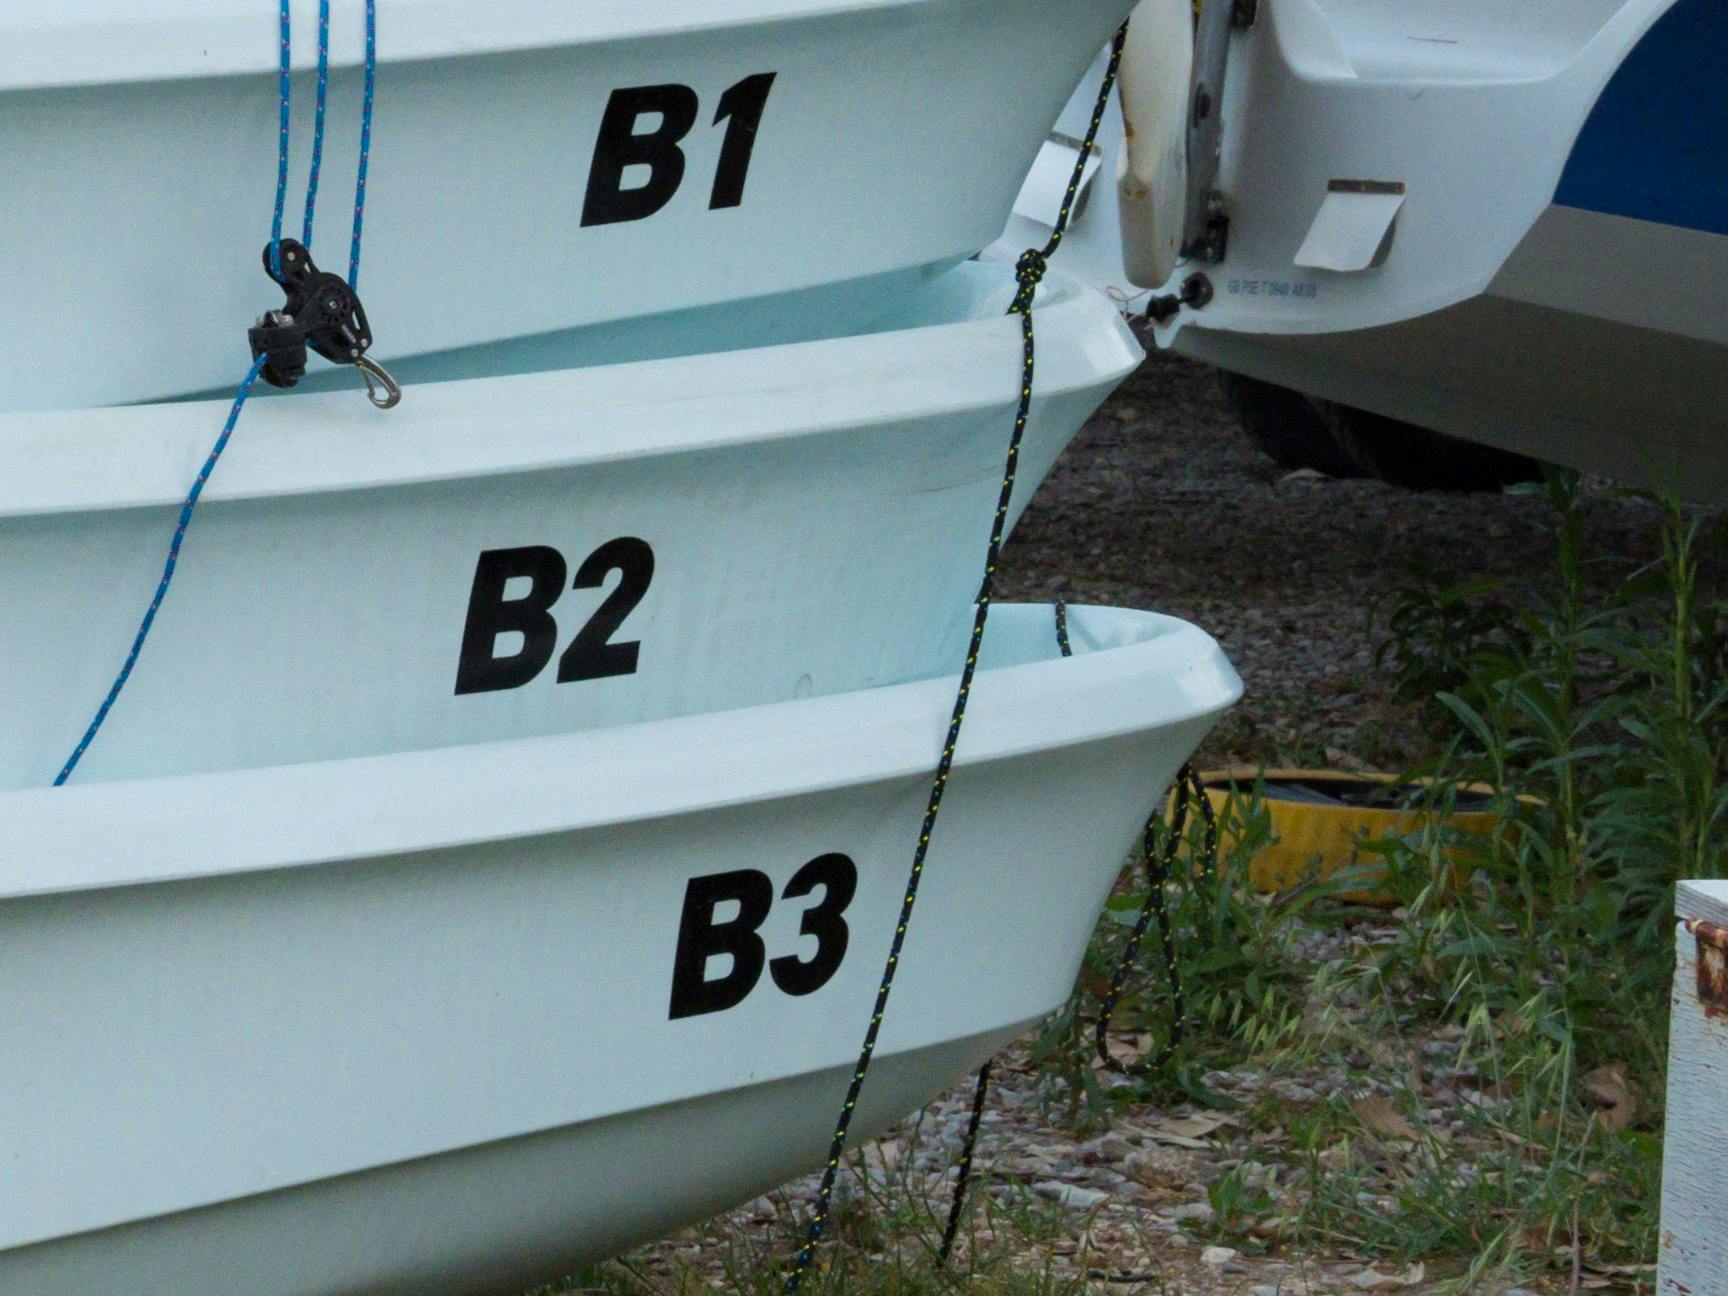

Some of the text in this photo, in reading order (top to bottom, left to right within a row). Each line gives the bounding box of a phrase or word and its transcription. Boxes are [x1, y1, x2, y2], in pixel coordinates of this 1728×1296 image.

[580, 72, 778, 228] B1
[455, 537, 655, 696] B2
[669, 852, 858, 1021] B3
